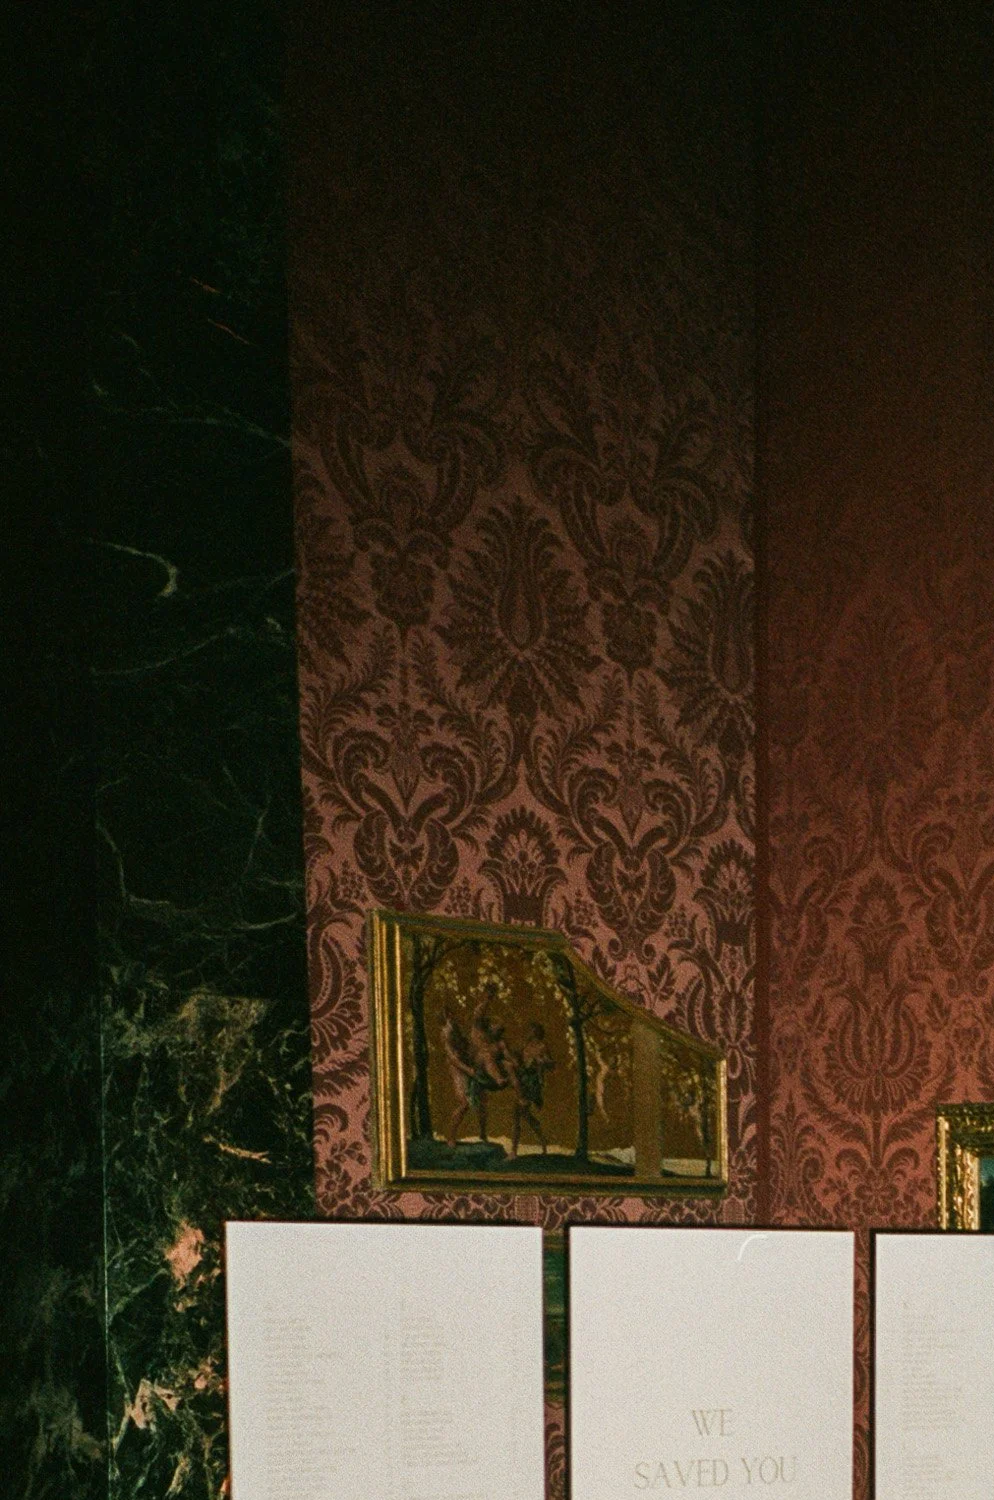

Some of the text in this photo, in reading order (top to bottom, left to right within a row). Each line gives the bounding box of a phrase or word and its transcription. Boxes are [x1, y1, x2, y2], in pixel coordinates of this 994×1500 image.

[692, 1409, 736, 1437] WE
[634, 1456, 798, 1490] SAVED YOU
